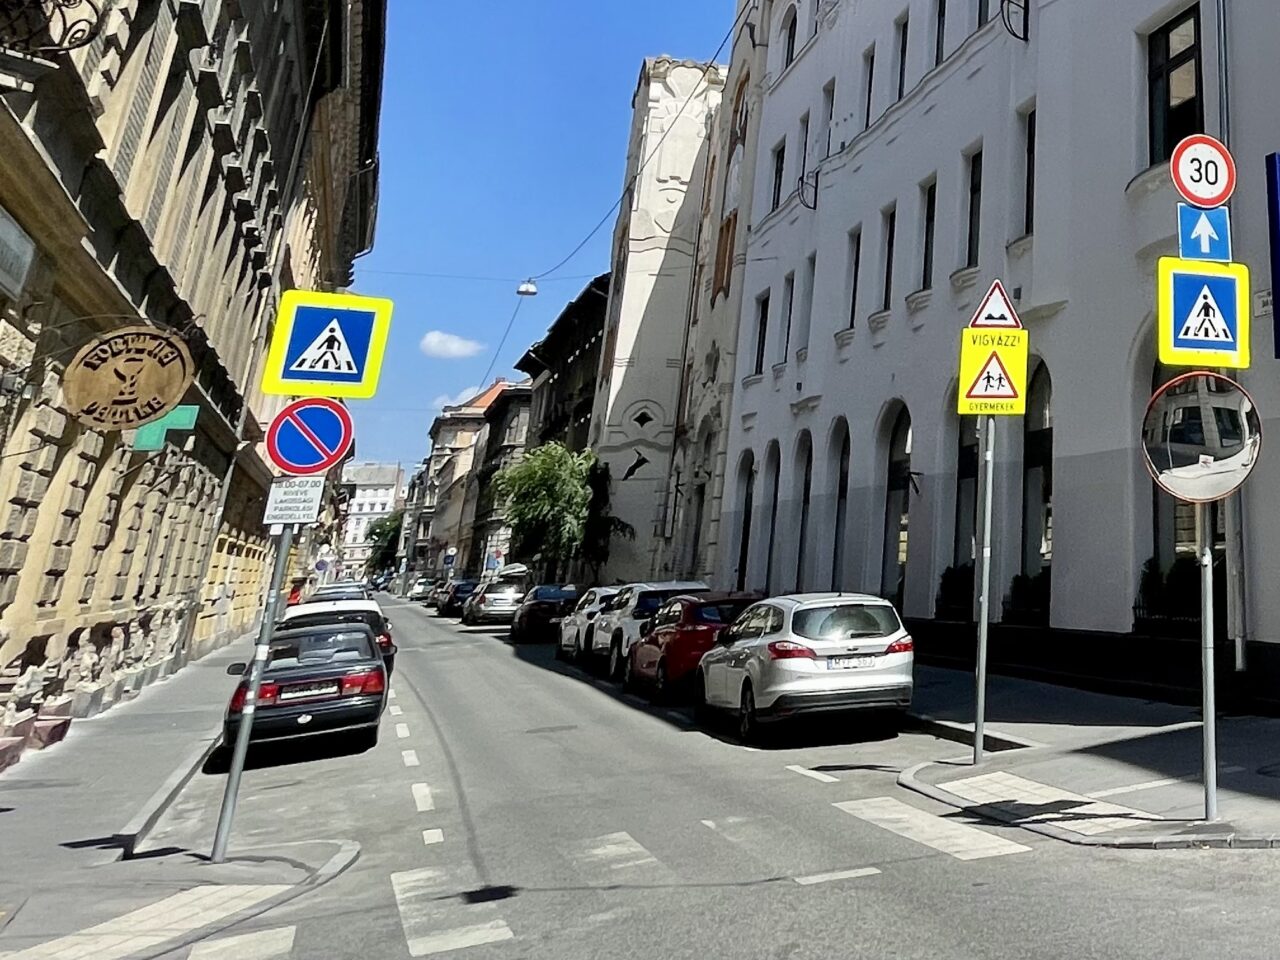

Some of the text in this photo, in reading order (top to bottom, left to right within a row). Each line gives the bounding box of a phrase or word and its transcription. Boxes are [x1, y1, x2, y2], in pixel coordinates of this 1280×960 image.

[1189, 157, 1219, 185] 30
[971, 332, 1020, 347] VIGYÁZZ!
[969, 402, 1015, 411] GYERMEKEK
